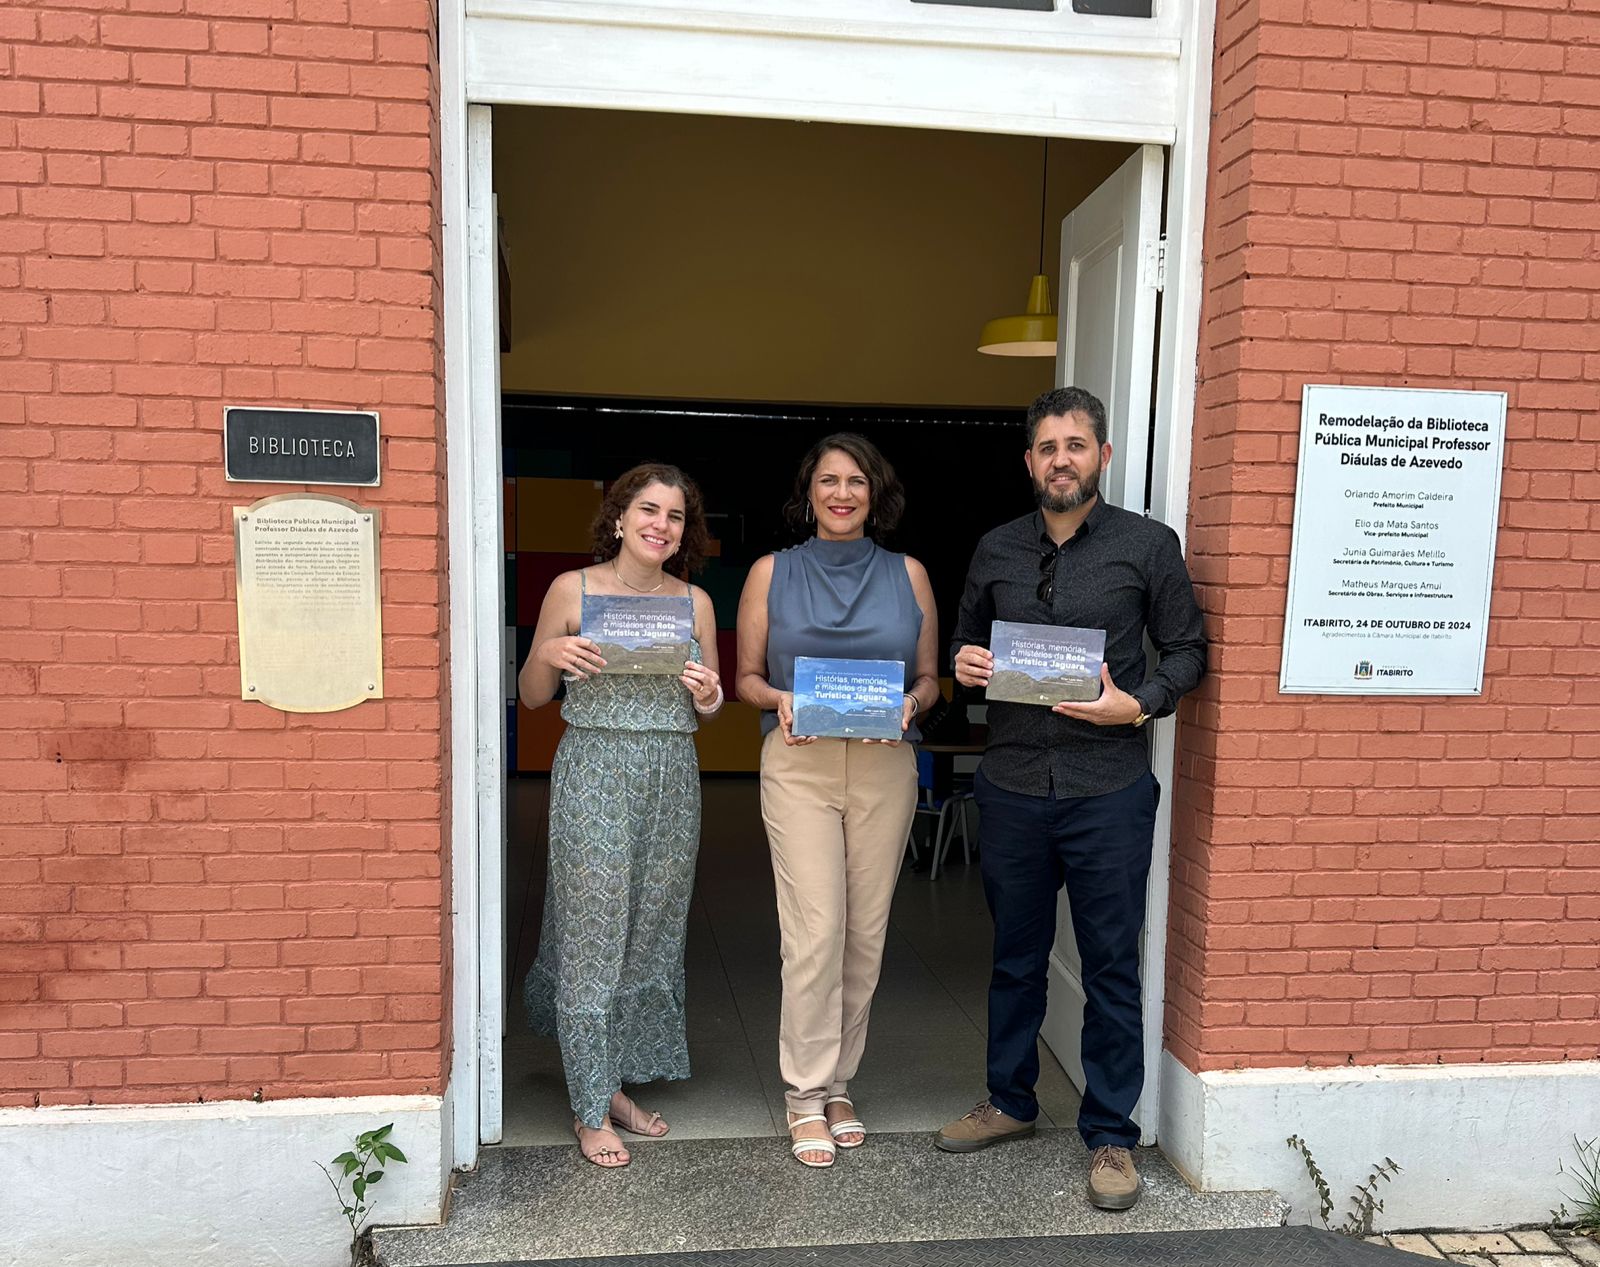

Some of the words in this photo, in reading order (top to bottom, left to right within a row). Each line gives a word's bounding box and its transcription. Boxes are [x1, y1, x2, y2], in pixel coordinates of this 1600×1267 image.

[1319, 414, 1404, 431] Remodelação
[1408, 417, 1423, 429] da
[1427, 418, 1489, 432] Biblioteca
[1315, 432, 1361, 446] Pública
[1366, 434, 1428, 451] Municipal
[1432, 437, 1491, 451] Professor
[249, 436, 356, 458] BIBLIOTECA
[1340, 453, 1387, 467] Diáulas
[1391, 455, 1406, 467] de
[1410, 456, 1463, 469] Azevedo
[1344, 489, 1379, 499] Orlando
[1382, 491, 1415, 500] Amorim
[1418, 492, 1453, 501] Caldeira
[1387, 520, 1408, 529] Mata
[1410, 521, 1439, 530] Santos
[1343, 548, 1367, 557] Junia
[1369, 548, 1415, 558] Guimarães
[1417, 550, 1446, 558] Melillo
[1342, 580, 1378, 588] Matheus
[1381, 581, 1417, 590] Marques
[603, 613, 638, 621] Histórias,
[1304, 619, 1354, 628] ITABIRITO,
[1356, 620, 1368, 628] 24
[1371, 620, 1383, 628] DE
[1385, 620, 1431, 629] OUTUBRO
[1012, 640, 1046, 651] Histórias,
[1049, 644, 1086, 654] memórias
[1018, 650, 1052, 658] mistérios
[1010, 657, 1047, 666] Turística
[1050, 661, 1085, 670] Jaguara
[816, 675, 850, 684] Histórias,
[851, 676, 887, 685] memórias
[822, 683, 855, 692] mistérios
[815, 691, 851, 699] Turística
[854, 692, 887, 701] Jaguara
